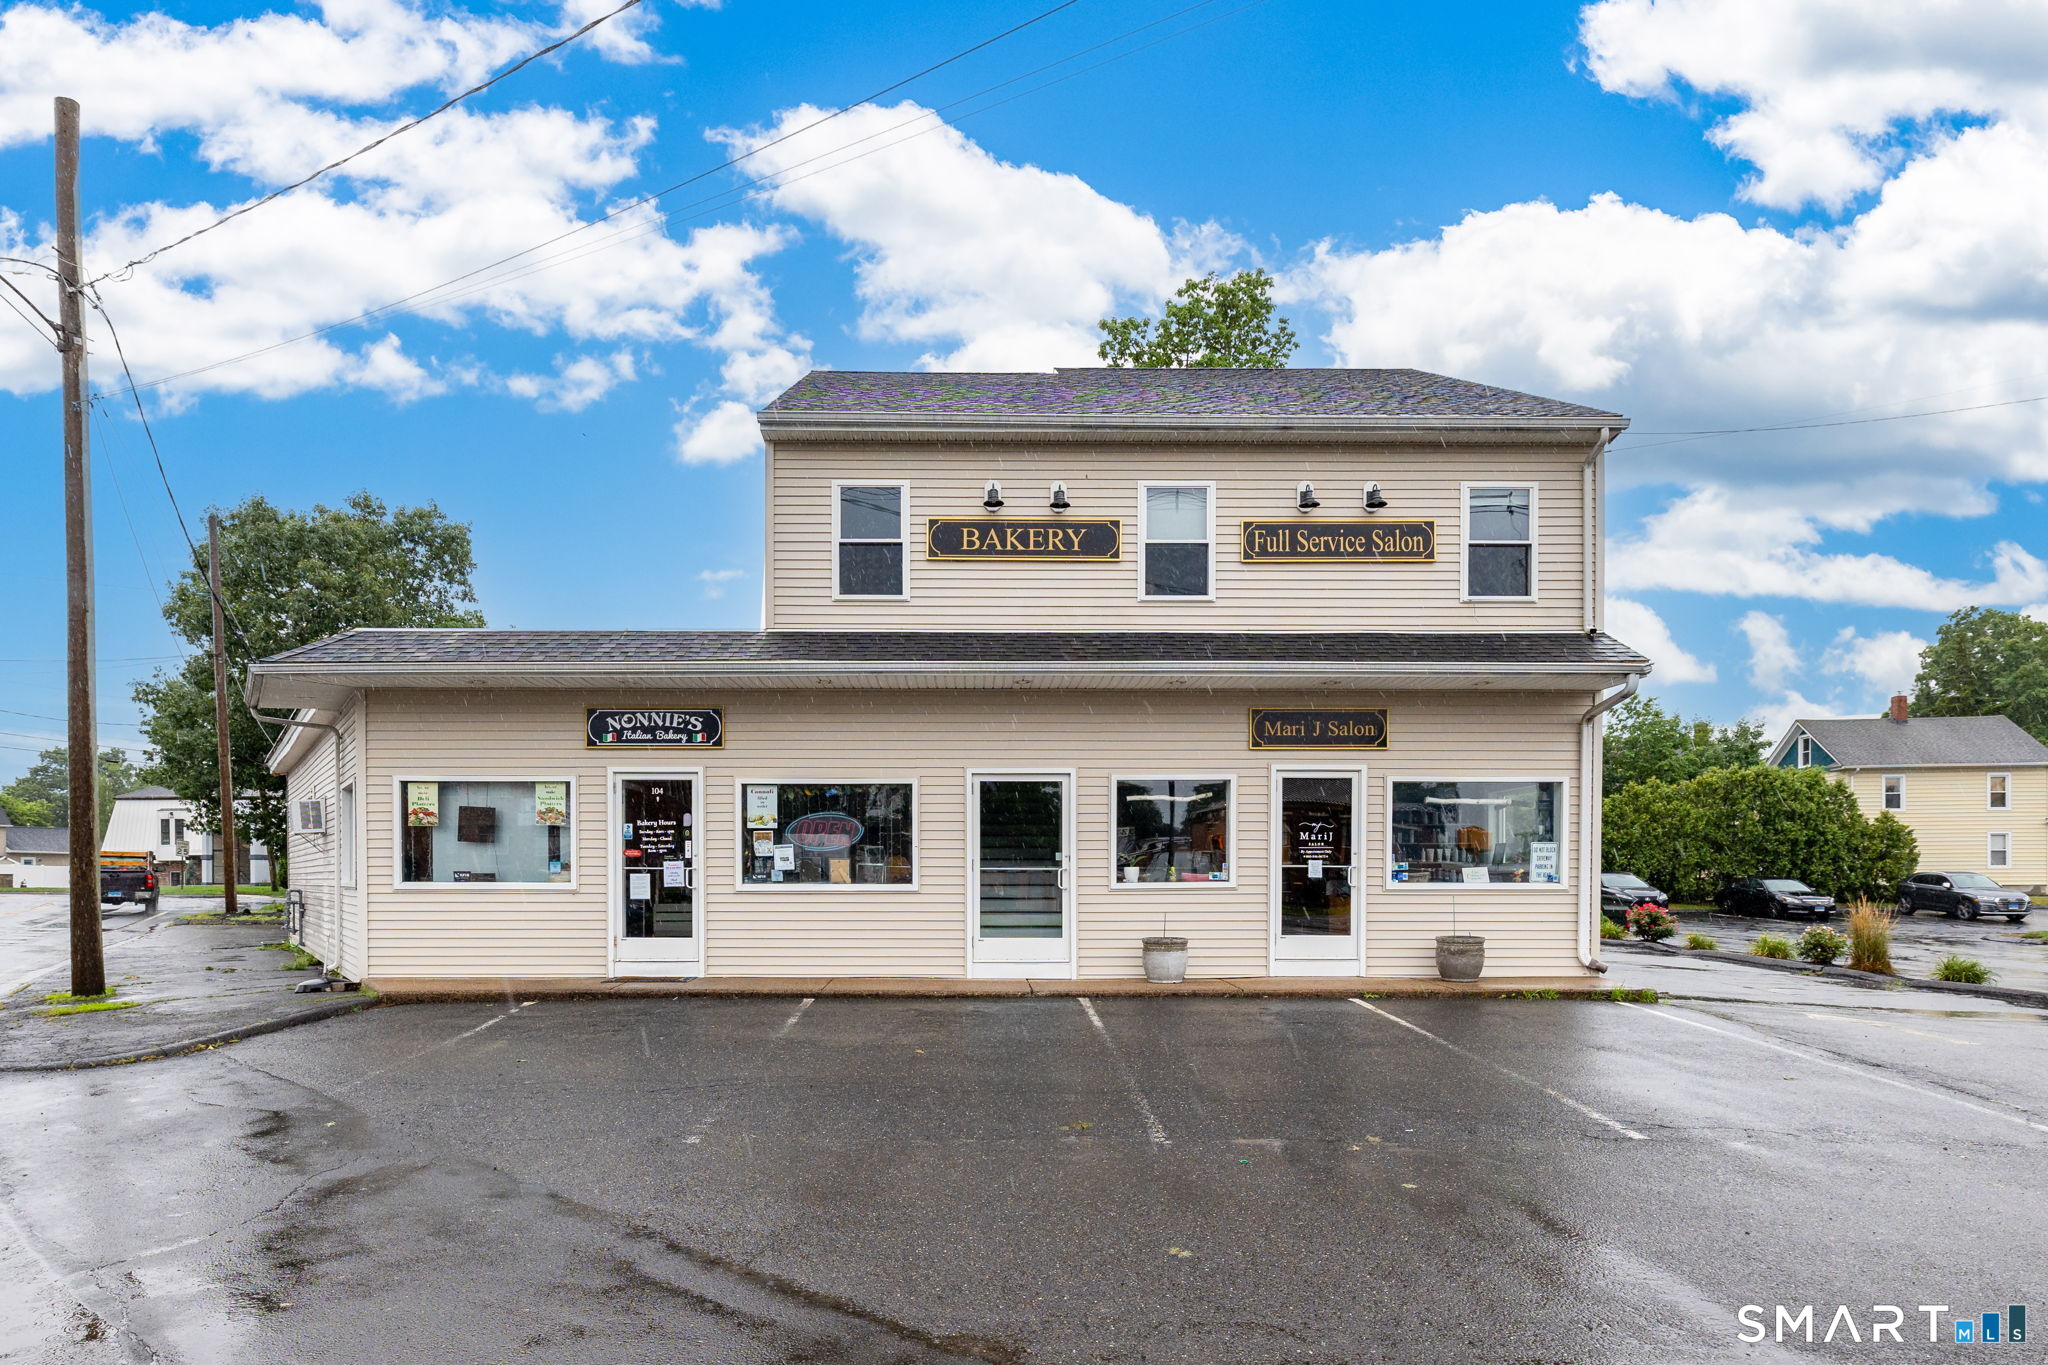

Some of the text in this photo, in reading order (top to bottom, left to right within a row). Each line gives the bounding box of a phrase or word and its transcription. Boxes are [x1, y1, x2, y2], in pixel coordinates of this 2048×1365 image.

[960, 528, 1088, 551] BAKERY
[1253, 528, 1425, 552] Full Service Salon
[606, 712, 704, 731] NONNIE'S
[1264, 720, 1377, 737] Mari J Salon
[621, 730, 688, 743] Italian Bakery
[651, 787, 664, 795] 104
[636, 819, 658, 828] Bakery
[796, 819, 856, 846] OPEN
